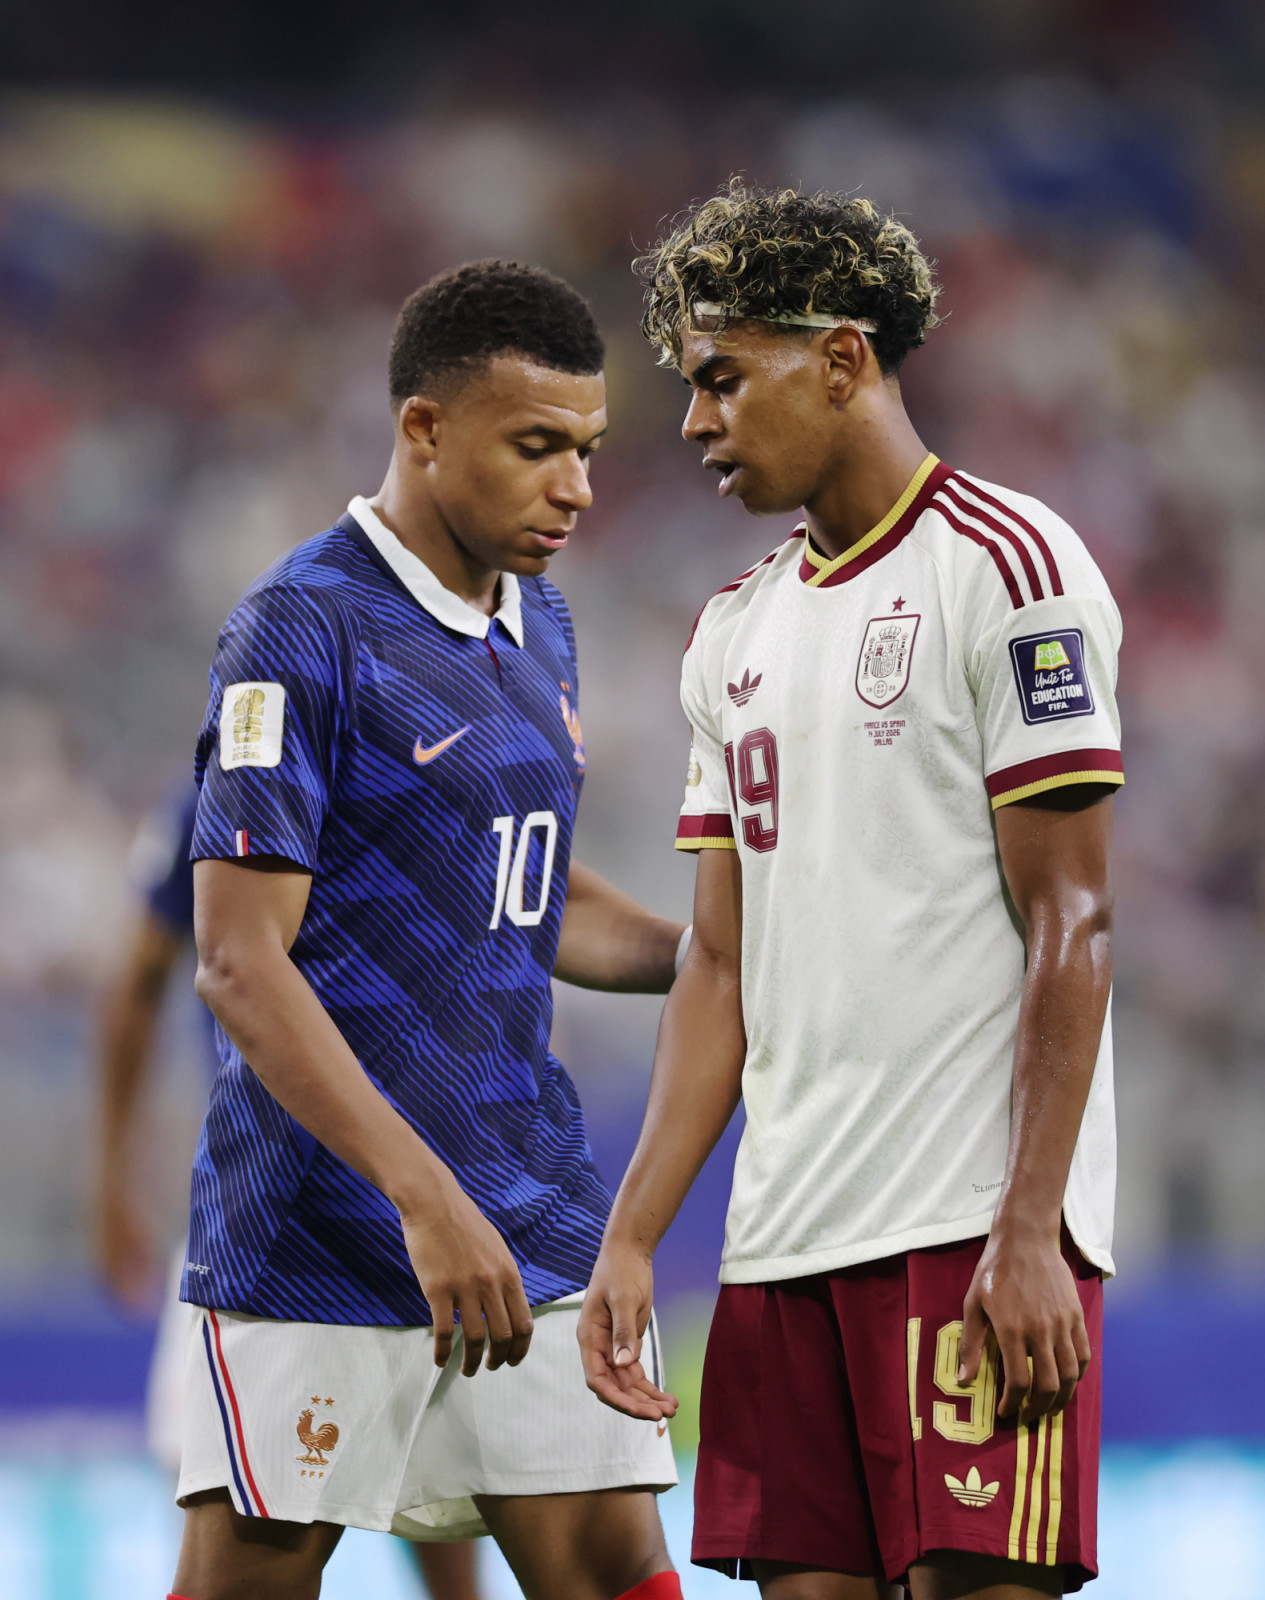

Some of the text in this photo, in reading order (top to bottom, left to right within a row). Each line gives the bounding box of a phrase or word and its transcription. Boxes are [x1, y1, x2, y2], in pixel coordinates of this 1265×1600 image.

[1034, 668, 1074, 688] Unite For
[1031, 683, 1083, 705] EDUCATION
[1048, 701, 1069, 711] FIFA
[864, 720, 905, 729] FRANCE VS SPAIN
[874, 738, 893, 746] DALLAS
[232, 751, 260, 761] 2026
[723, 726, 779, 853] 19
[489, 810, 558, 930] 10
[906, 1317, 997, 1445] 19
